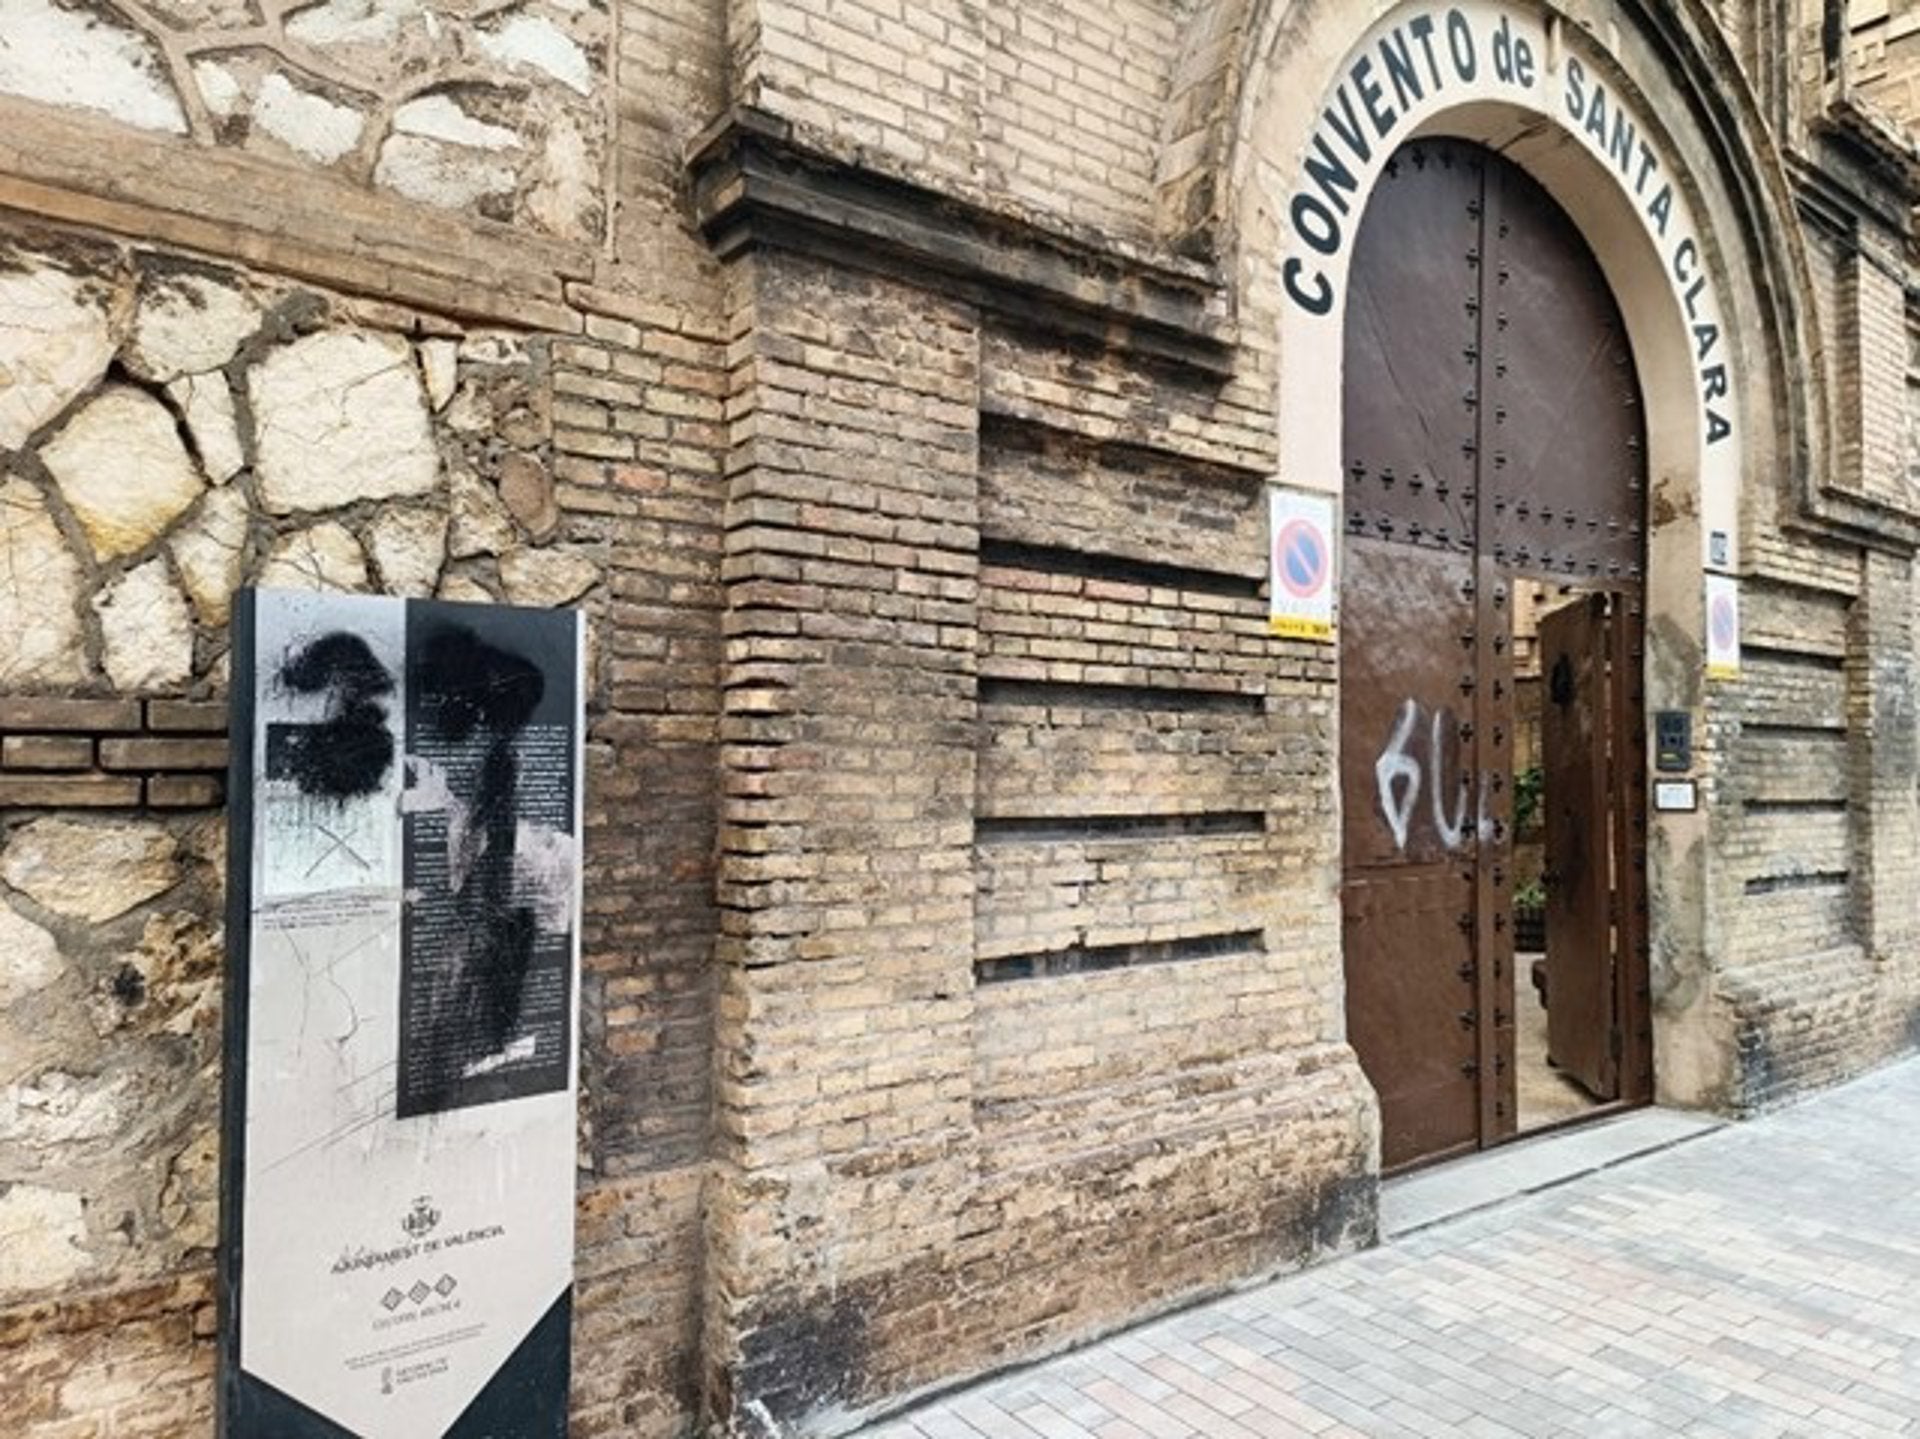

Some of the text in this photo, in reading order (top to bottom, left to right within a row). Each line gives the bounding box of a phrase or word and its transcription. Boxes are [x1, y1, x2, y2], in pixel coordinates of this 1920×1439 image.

[1282, 8, 1732, 446] CONVENTO de SANTA CLARA
